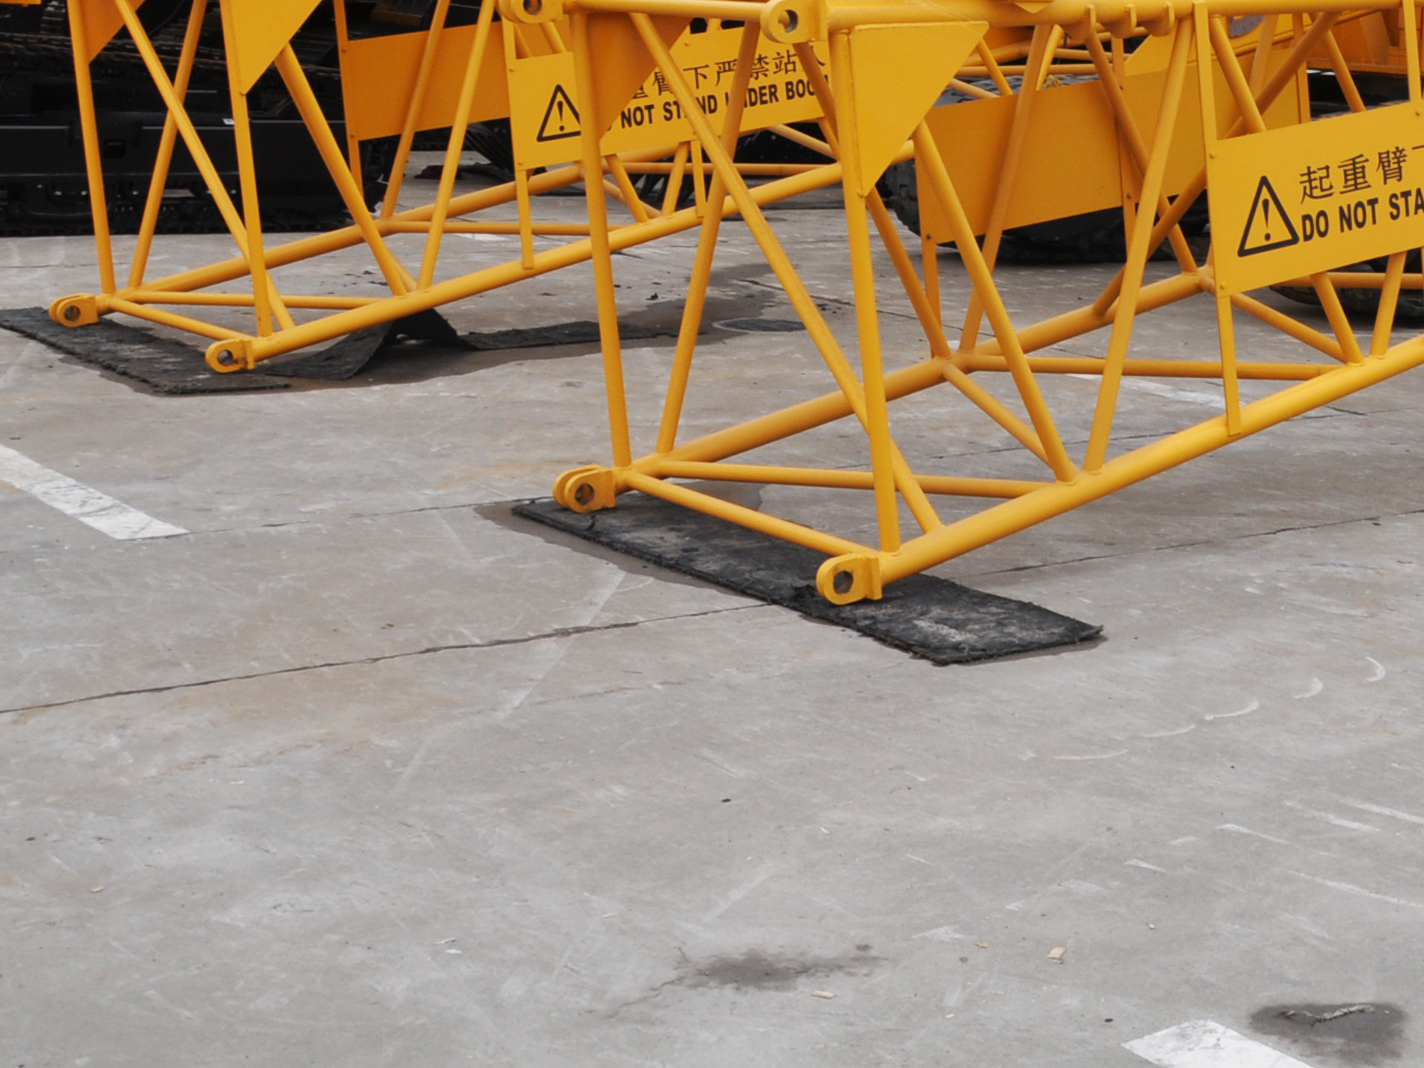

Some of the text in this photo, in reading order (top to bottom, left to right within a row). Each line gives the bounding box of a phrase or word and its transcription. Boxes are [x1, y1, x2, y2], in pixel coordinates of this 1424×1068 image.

[620, 74, 829, 129] NOT STND DER BOO
[1301, 210, 1329, 242] DO
[1338, 197, 1379, 233] NOT
